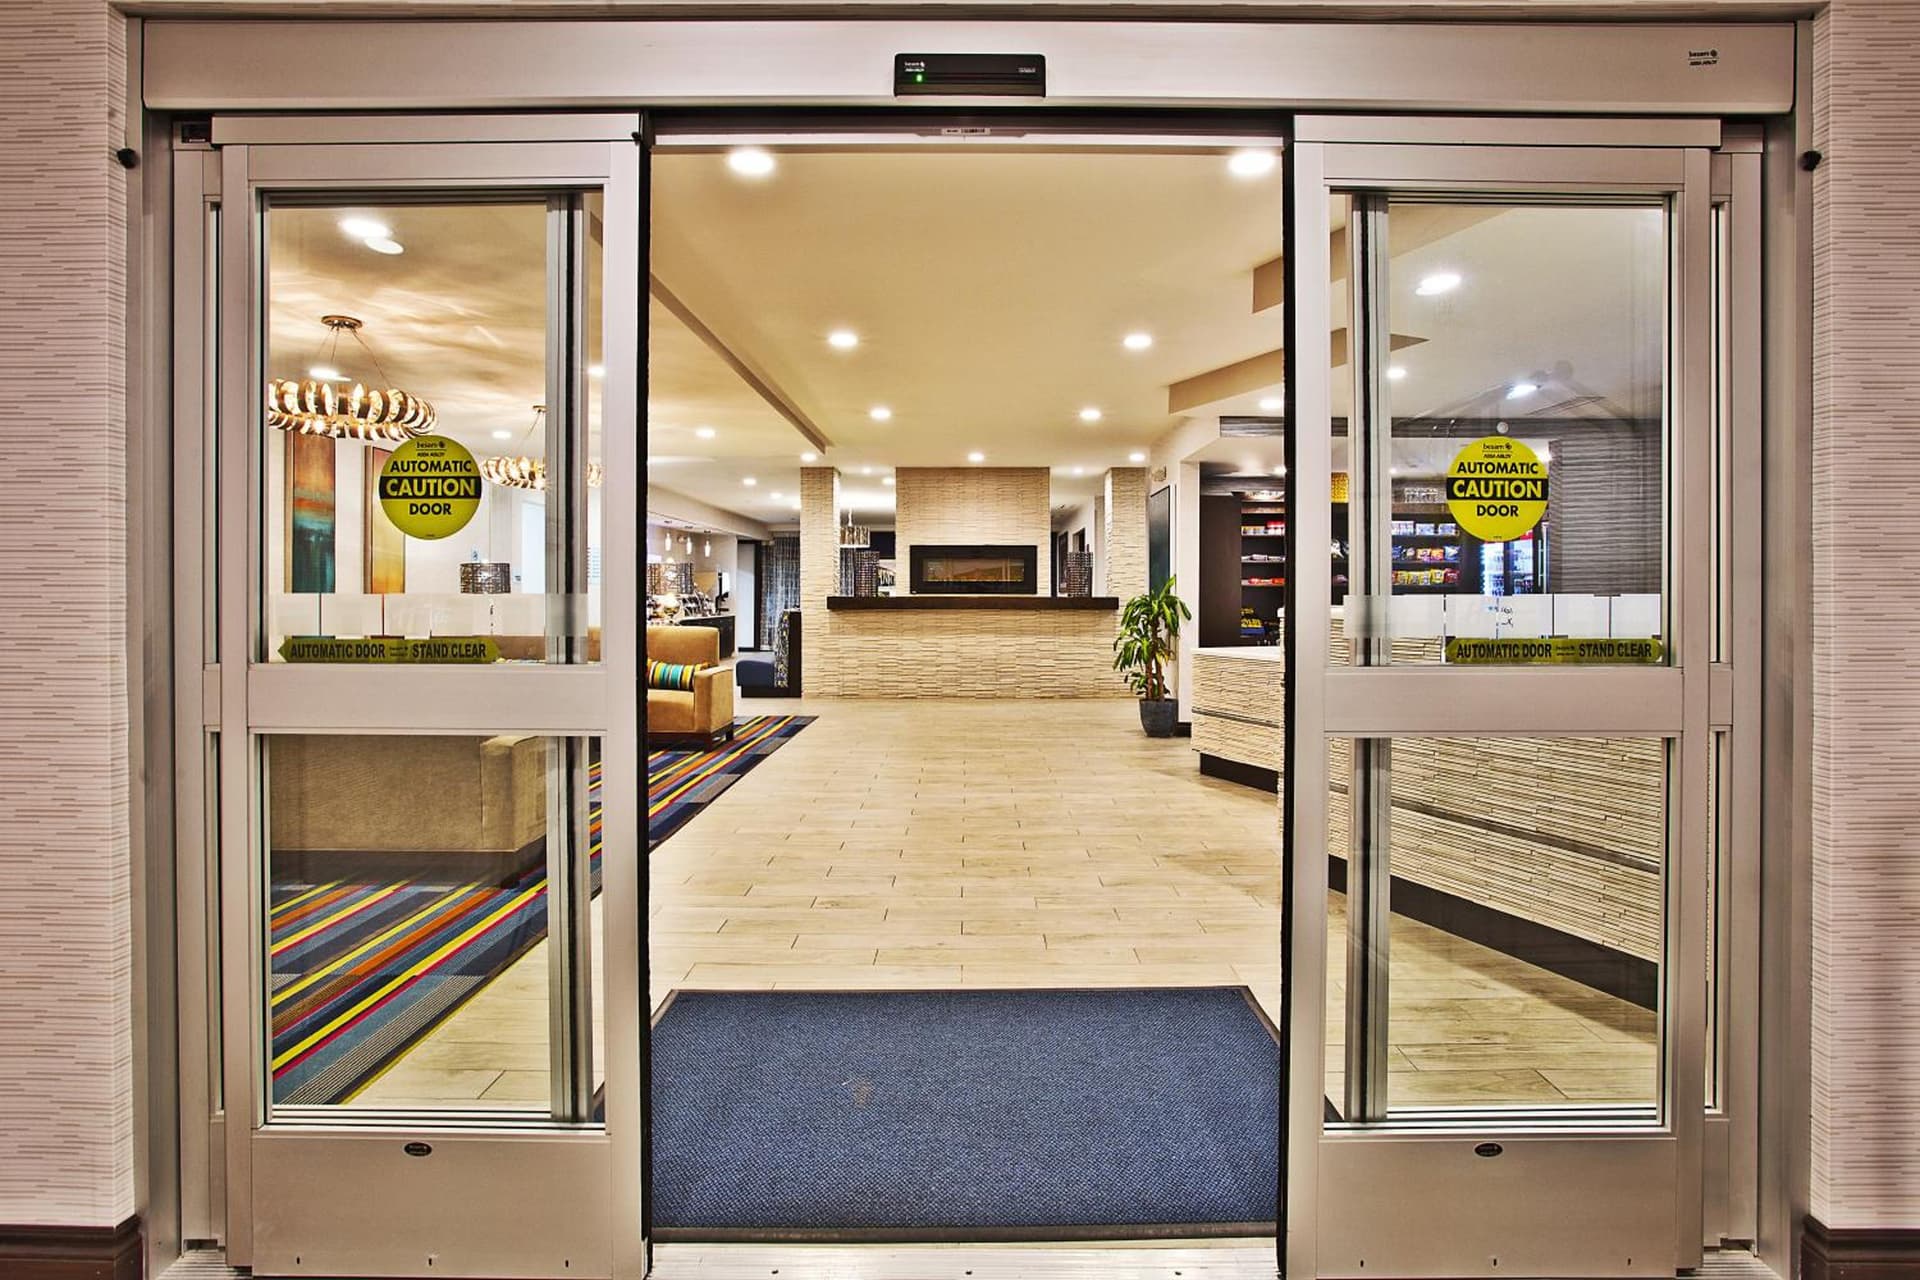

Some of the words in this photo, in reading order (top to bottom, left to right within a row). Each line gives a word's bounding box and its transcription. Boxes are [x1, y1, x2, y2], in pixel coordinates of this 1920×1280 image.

[390, 460, 472, 473] AUTOMATIC
[1457, 462, 1539, 474] AUTOMATIC
[386, 478, 476, 497] CAUTION
[1453, 480, 1542, 498] CAUTION
[409, 503, 452, 515] DOOR
[1476, 505, 1519, 517] DOOR
[291, 643, 353, 659] AUTOMATIC
[355, 643, 385, 659] DOOR
[412, 643, 448, 658] STAND
[451, 643, 486, 658] CLEAR
[1457, 643, 1520, 659] AUTOMATIC
[1522, 643, 1552, 658] DOOR
[1579, 643, 1614, 658] STAND
[1617, 643, 1652, 658] CLEAR
